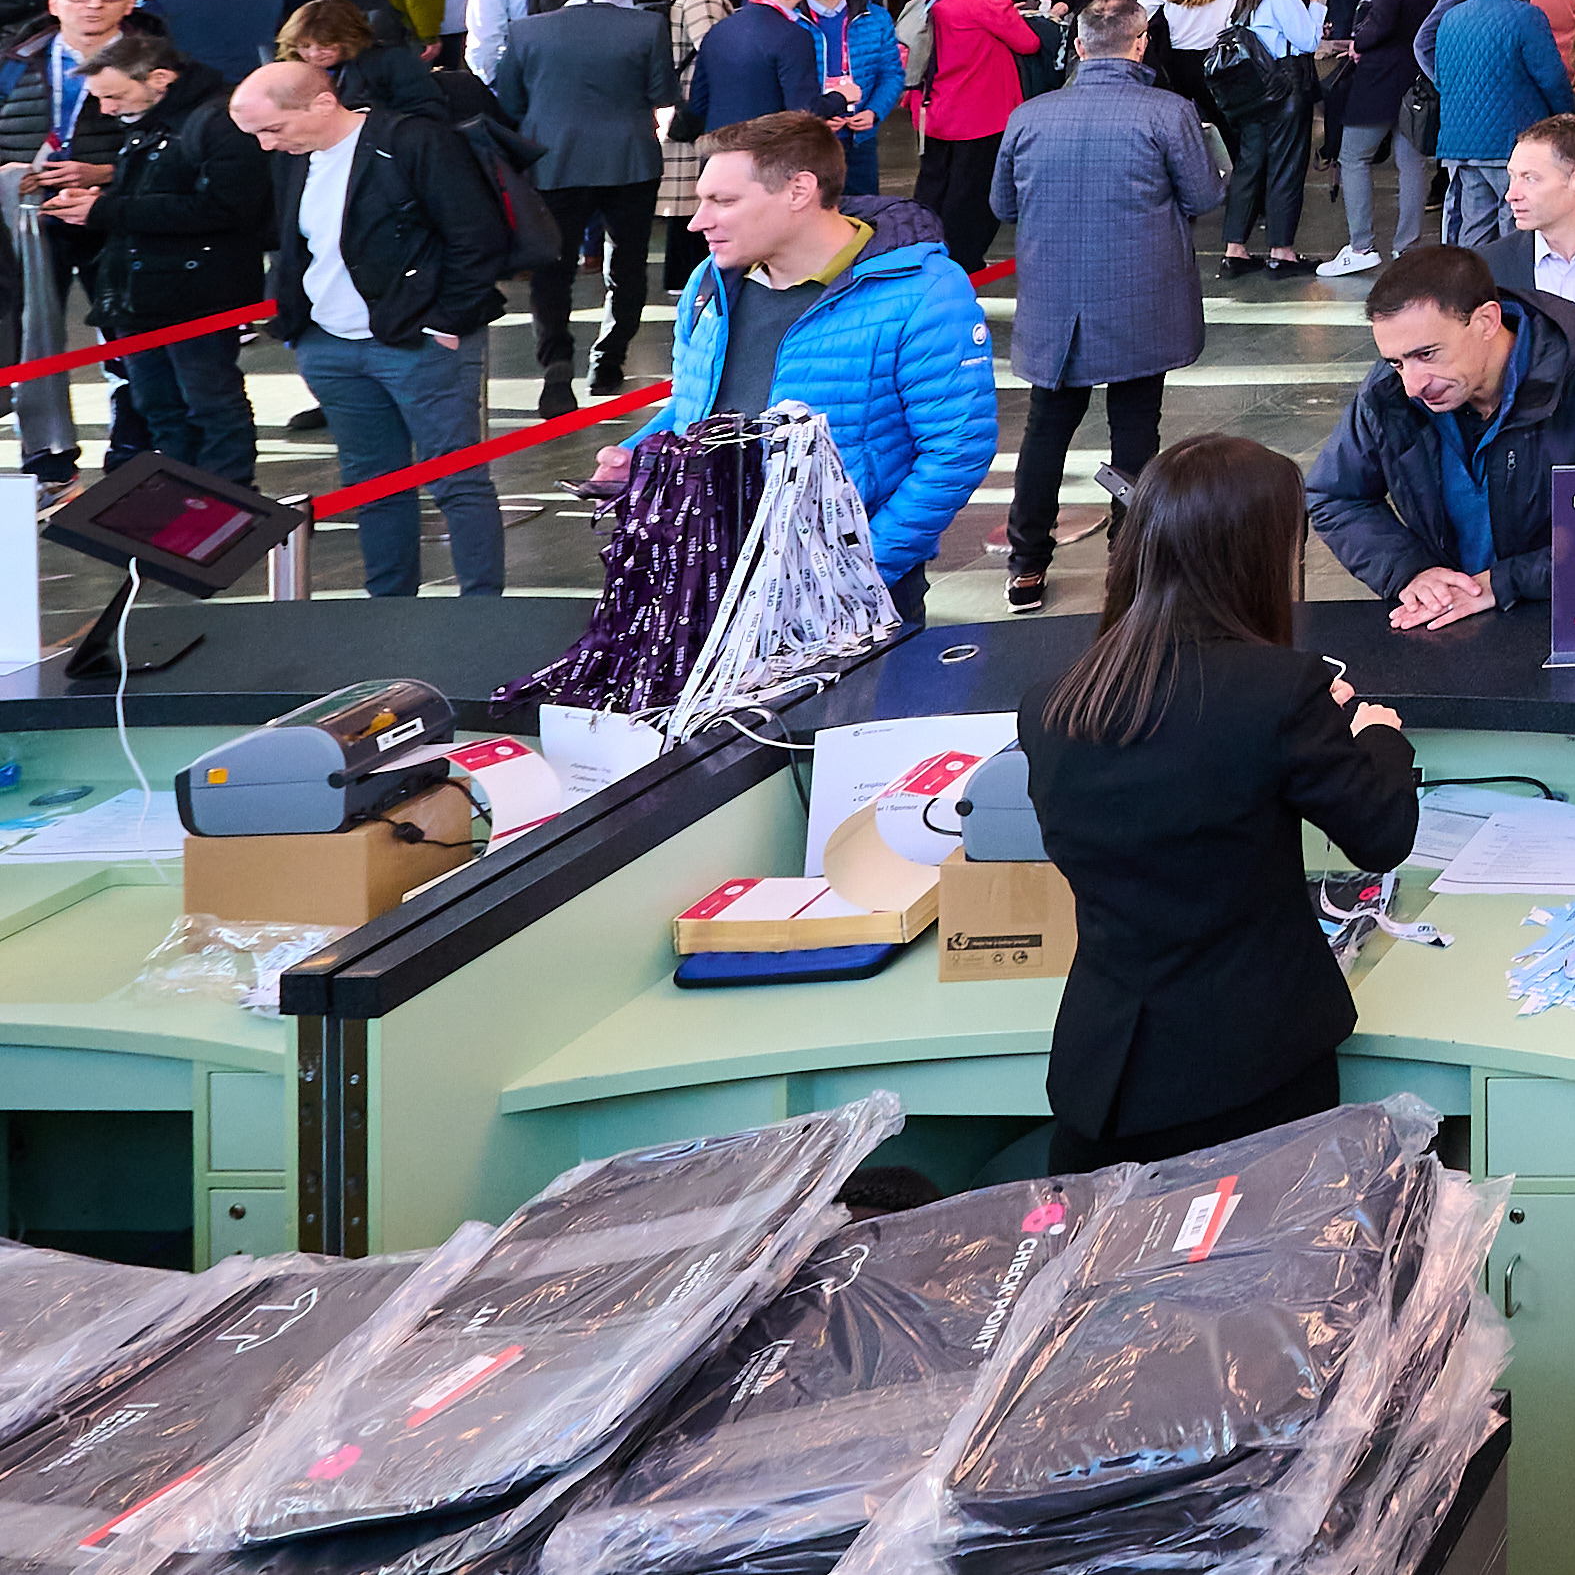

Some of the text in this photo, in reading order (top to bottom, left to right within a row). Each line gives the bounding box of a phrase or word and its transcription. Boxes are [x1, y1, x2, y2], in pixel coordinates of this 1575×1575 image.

[859, 781, 889, 790] Employ
[971, 1238, 1038, 1351] CHECK POINT
